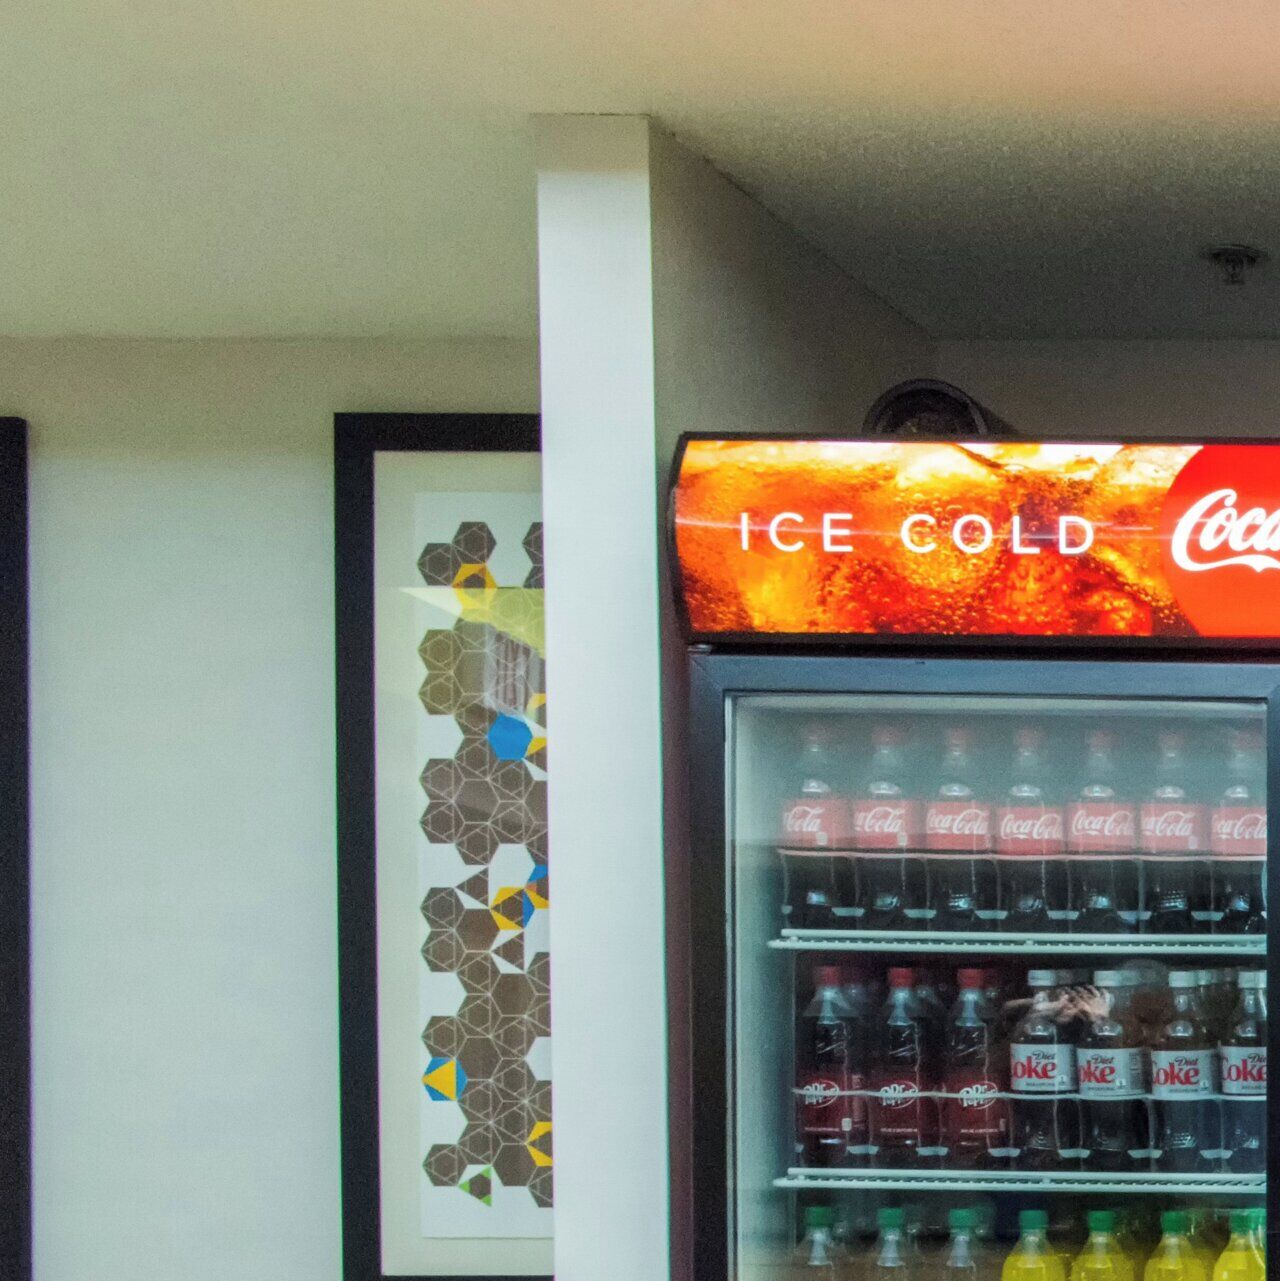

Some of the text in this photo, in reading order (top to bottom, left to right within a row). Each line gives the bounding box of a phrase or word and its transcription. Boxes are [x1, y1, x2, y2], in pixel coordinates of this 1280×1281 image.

[738, 511, 1097, 555] ICE COLD
[1011, 1057, 1056, 1081] oke
[1079, 1060, 1115, 1084] oke
